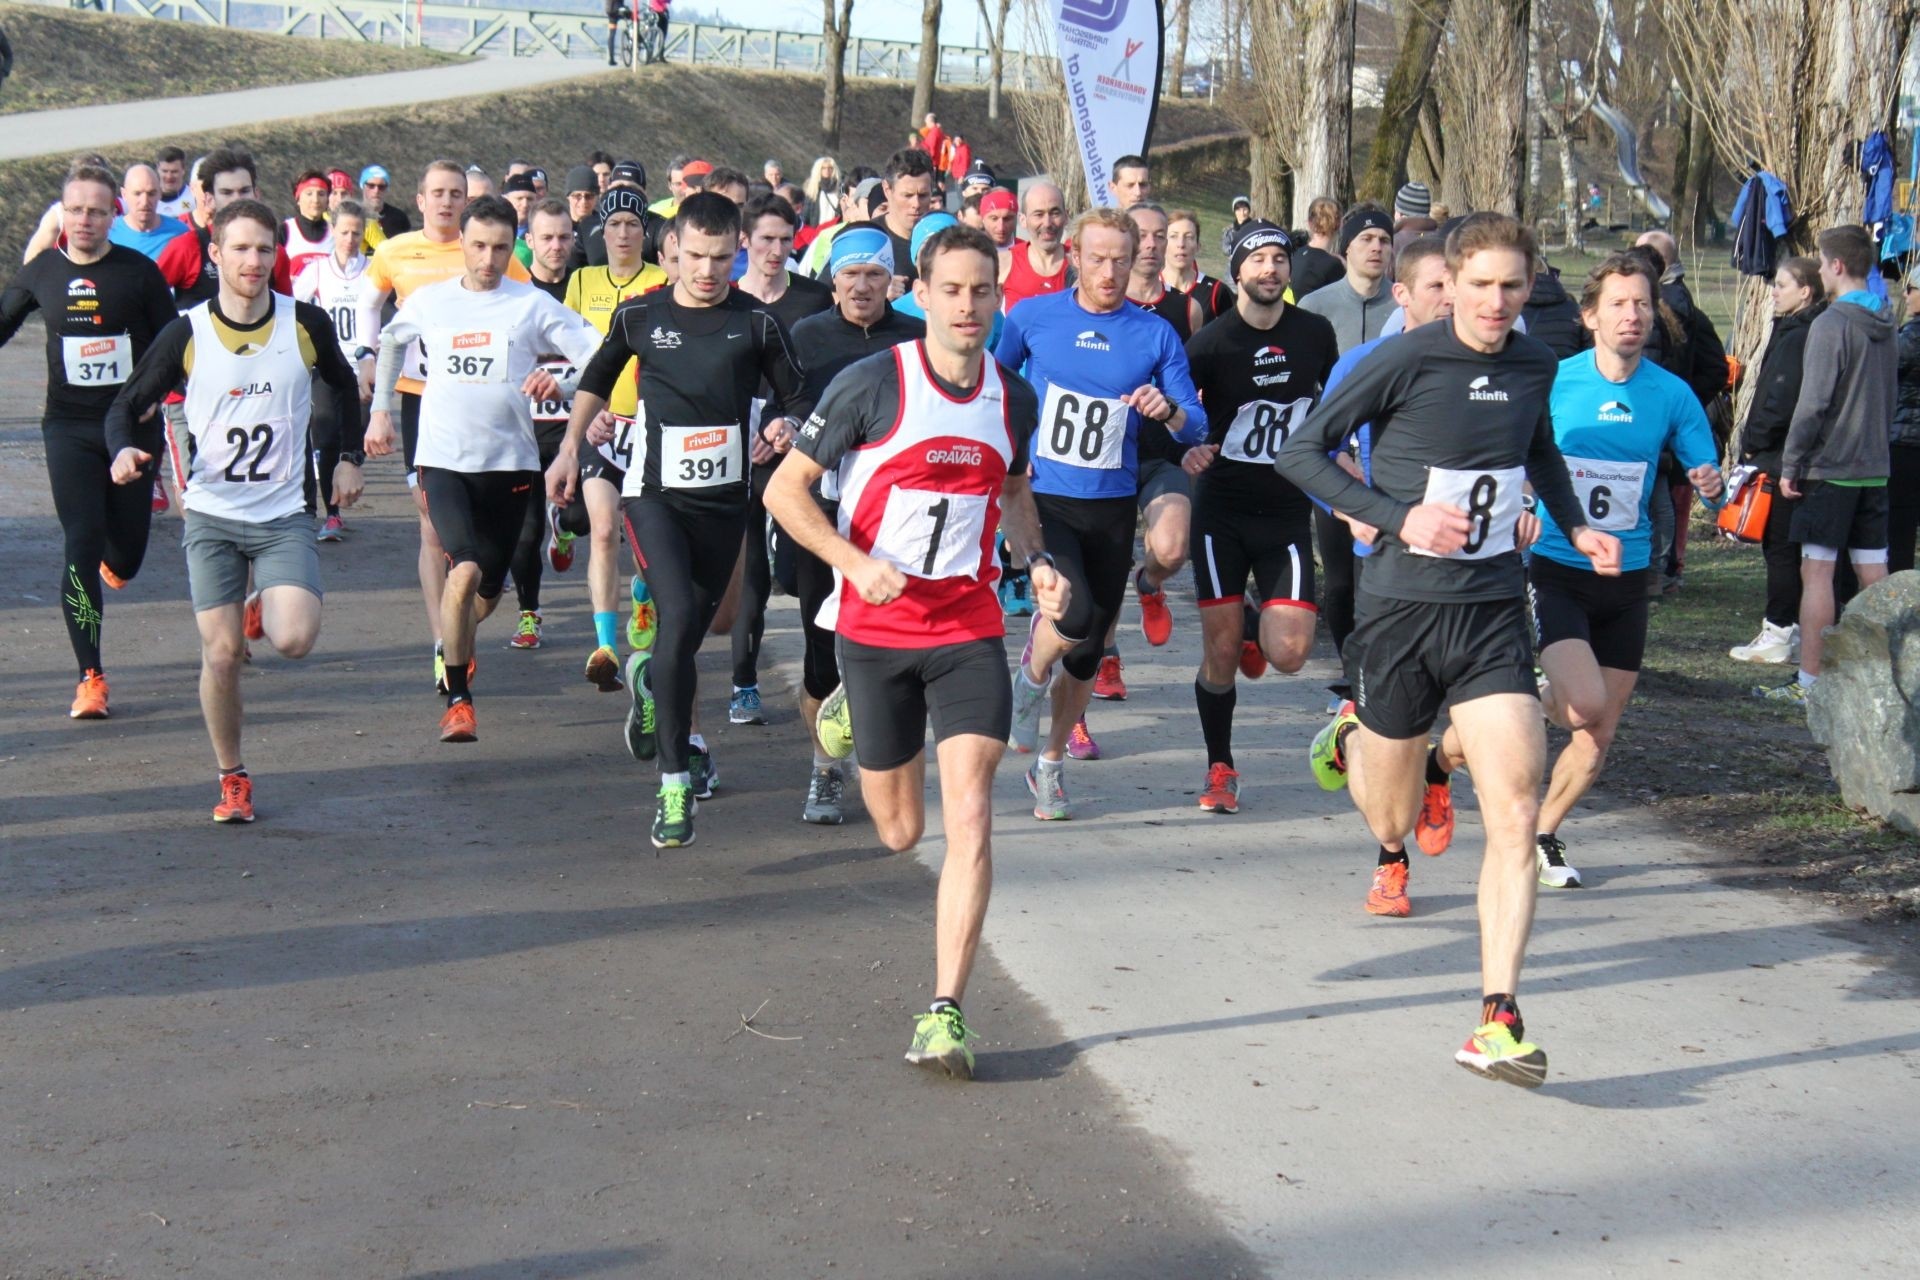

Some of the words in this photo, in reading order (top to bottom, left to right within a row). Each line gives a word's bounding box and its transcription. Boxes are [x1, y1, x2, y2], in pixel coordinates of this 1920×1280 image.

[68, 287, 97, 296] skinfit
[84, 342, 112, 355] rivella
[456, 334, 487, 346] rivella
[1075, 340, 1111, 352] skinfit
[447, 355, 494, 377] 367
[1254, 355, 1287, 367] skinfit
[79, 362, 119, 381] 371
[1468, 390, 1509, 402] skinfit
[1597, 412, 1633, 423] skinfit
[1050, 393, 1109, 462] 68
[688, 431, 722, 448] rivella
[225, 423, 274, 483] 22
[925, 449, 982, 466] GRAVAG
[679, 456, 728, 481] 391
[1585, 470, 1640, 481] Bausparkasse
[1588, 485, 1612, 520] 6
[1462, 474, 1498, 555] 8
[922, 497, 950, 575] 1
